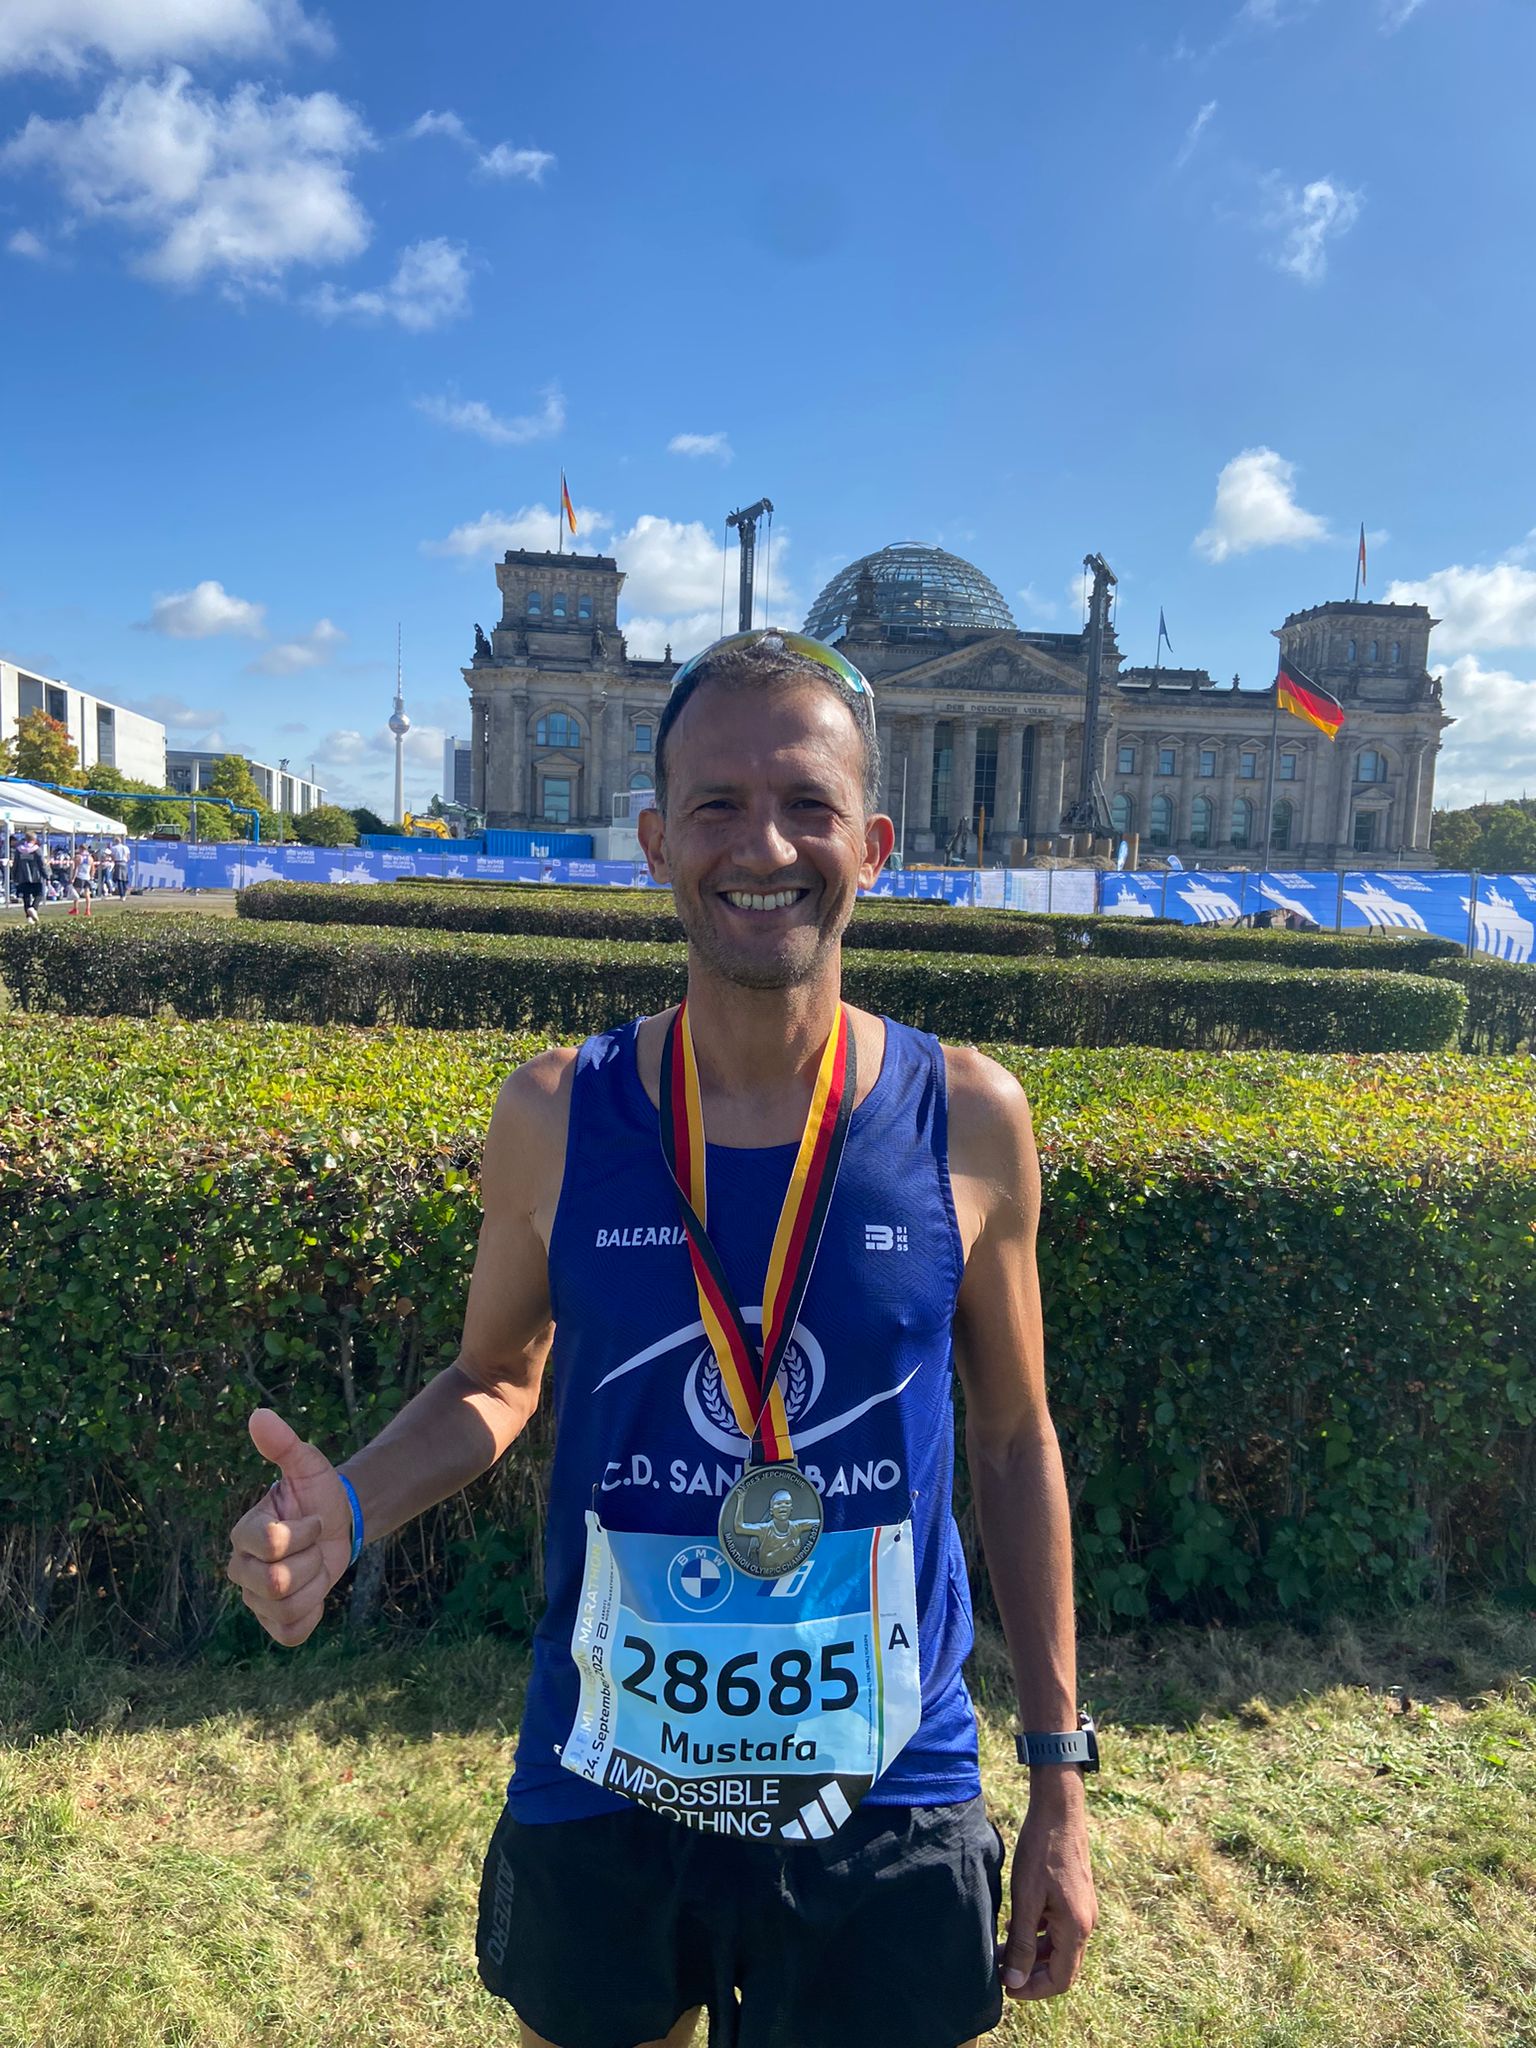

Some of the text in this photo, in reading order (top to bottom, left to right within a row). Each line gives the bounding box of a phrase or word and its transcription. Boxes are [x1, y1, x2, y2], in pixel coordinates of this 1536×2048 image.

[946, 703, 965, 711] DEM
[601, 1454, 660, 1492] C.D.
[797, 1458, 901, 1498] BANO
[677, 1549, 725, 1568] BMW
[724, 1523, 820, 1576] MARATHON OLYMPIC CHAMPION 2020
[888, 1622, 910, 1650] A
[621, 1634, 858, 1717] 28685
[583, 1756, 600, 1780] 24.
[592, 1645, 606, 1677] 2023
[660, 1721, 817, 1764] Mustafa
[608, 1756, 780, 1806] IMPOSSIBLE
